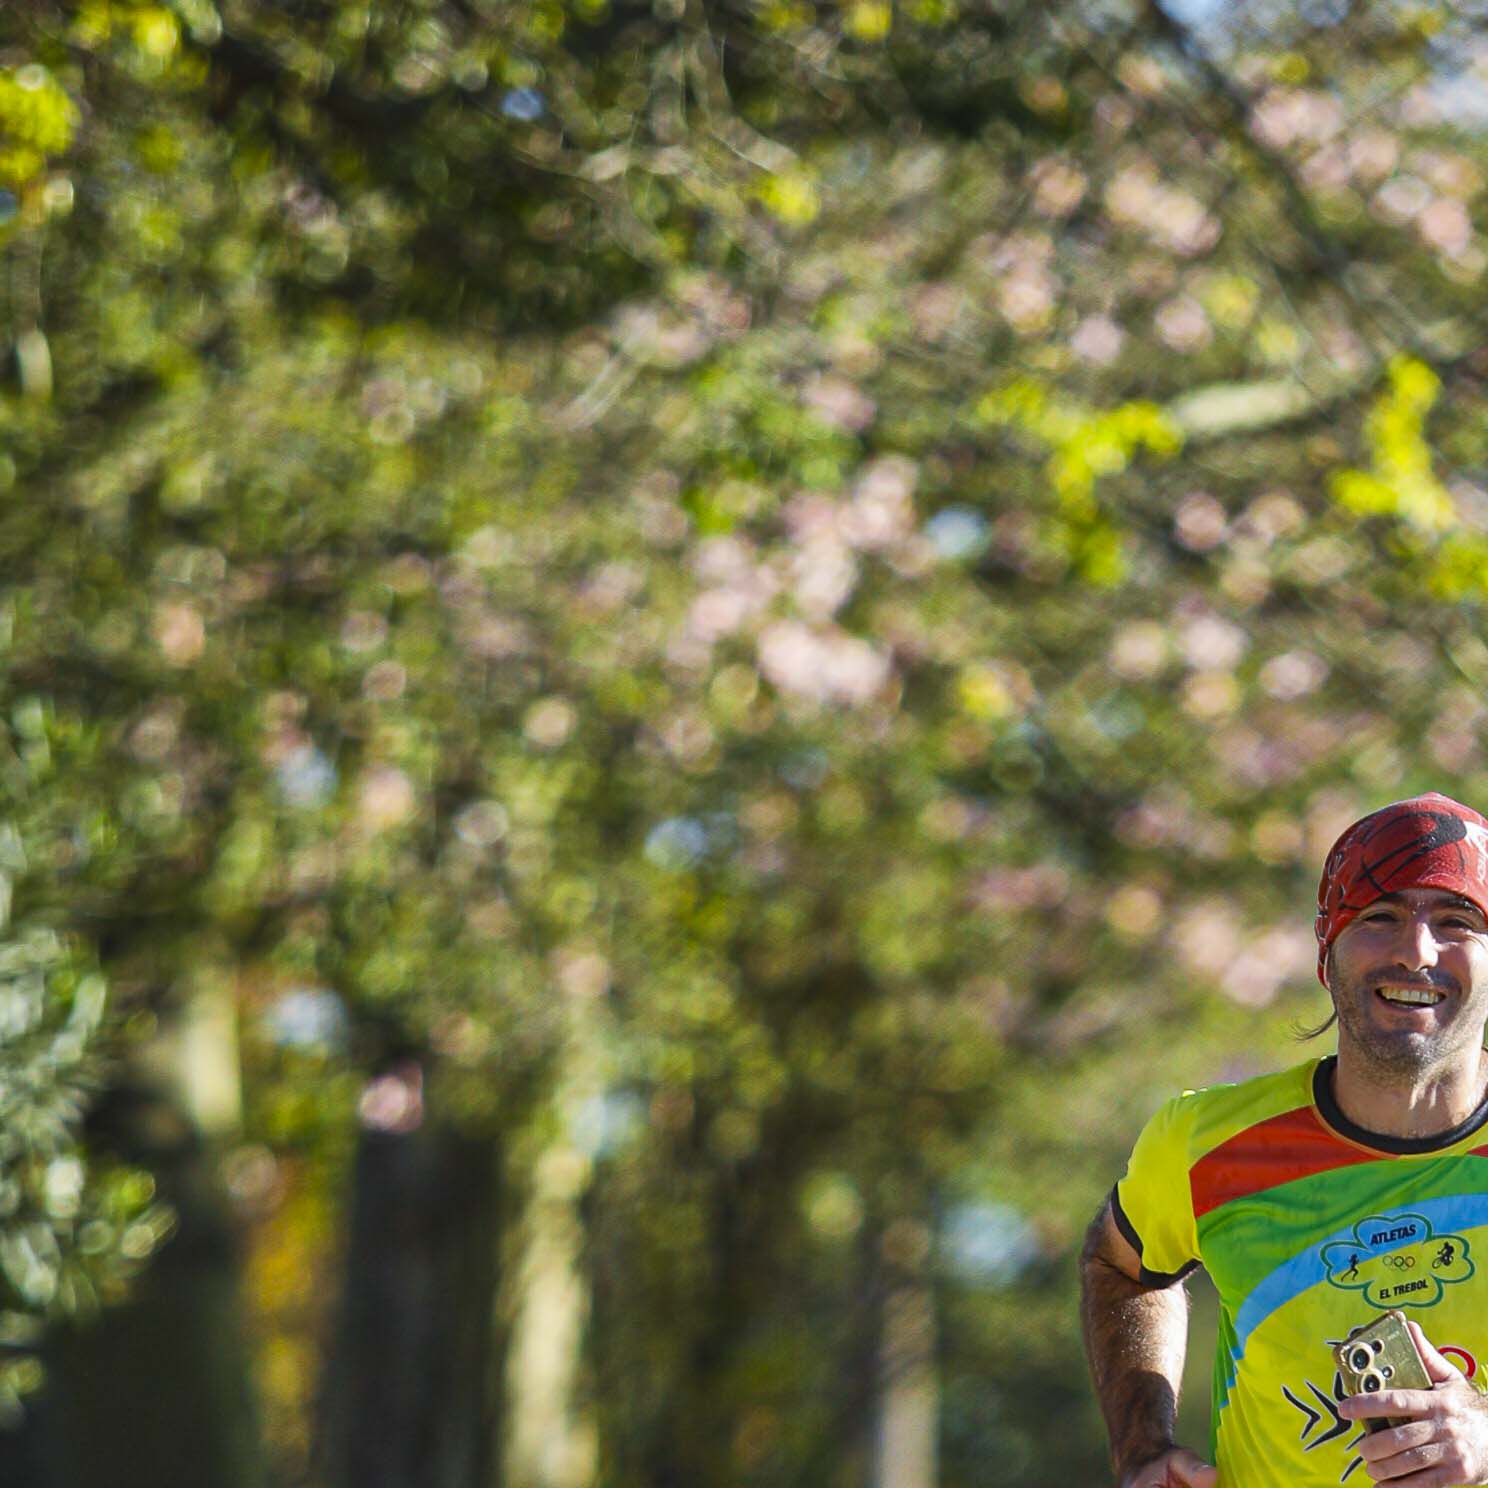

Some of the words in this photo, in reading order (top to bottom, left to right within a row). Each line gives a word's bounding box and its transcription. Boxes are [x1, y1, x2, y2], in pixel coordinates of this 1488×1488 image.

[1370, 1224, 1416, 1245] ATLETAS
[1379, 1288, 1391, 1299] EL
[1393, 1279, 1428, 1297] TREBOL
